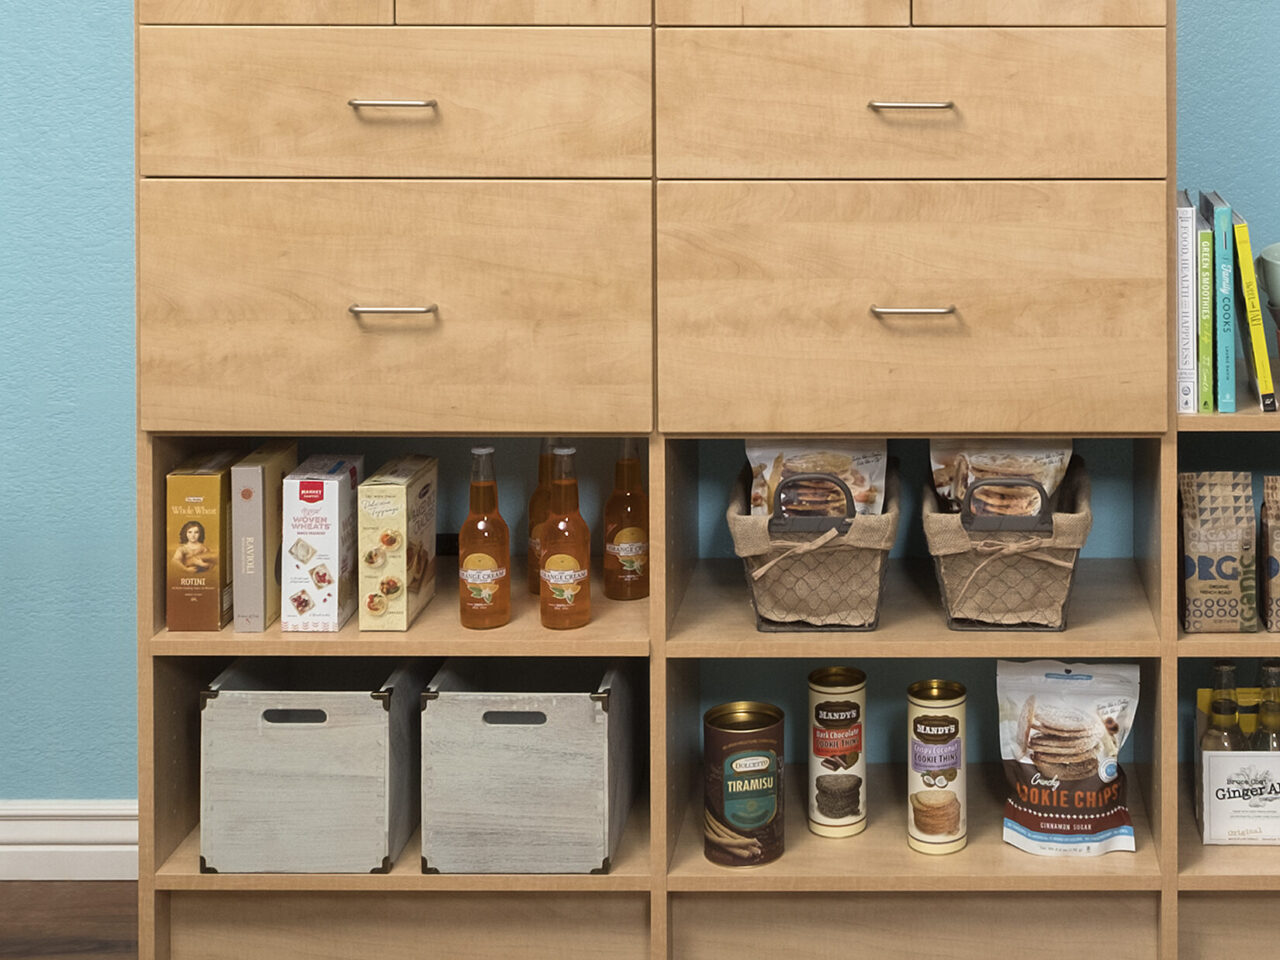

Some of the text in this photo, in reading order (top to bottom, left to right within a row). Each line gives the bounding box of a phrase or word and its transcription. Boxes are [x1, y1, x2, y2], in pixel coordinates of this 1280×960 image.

[1202, 241, 1210, 320] GREEN SMOOTHIES
[1222, 297, 1231, 333] COOKS
[171, 506, 217, 515] Whole Wheat
[1190, 541, 1239, 553] COFFEE
[246, 536, 255, 575] RAVIOLI
[1185, 554, 1239, 580] ORG
[914, 752, 957, 763] COOKIE THINS
[727, 777, 774, 792] TIRAMISU
[1074, 784, 1119, 808] CHIPS
[1215, 786, 1265, 800] Ginger
[1040, 822, 1092, 831] CINNAMON SUGAR
